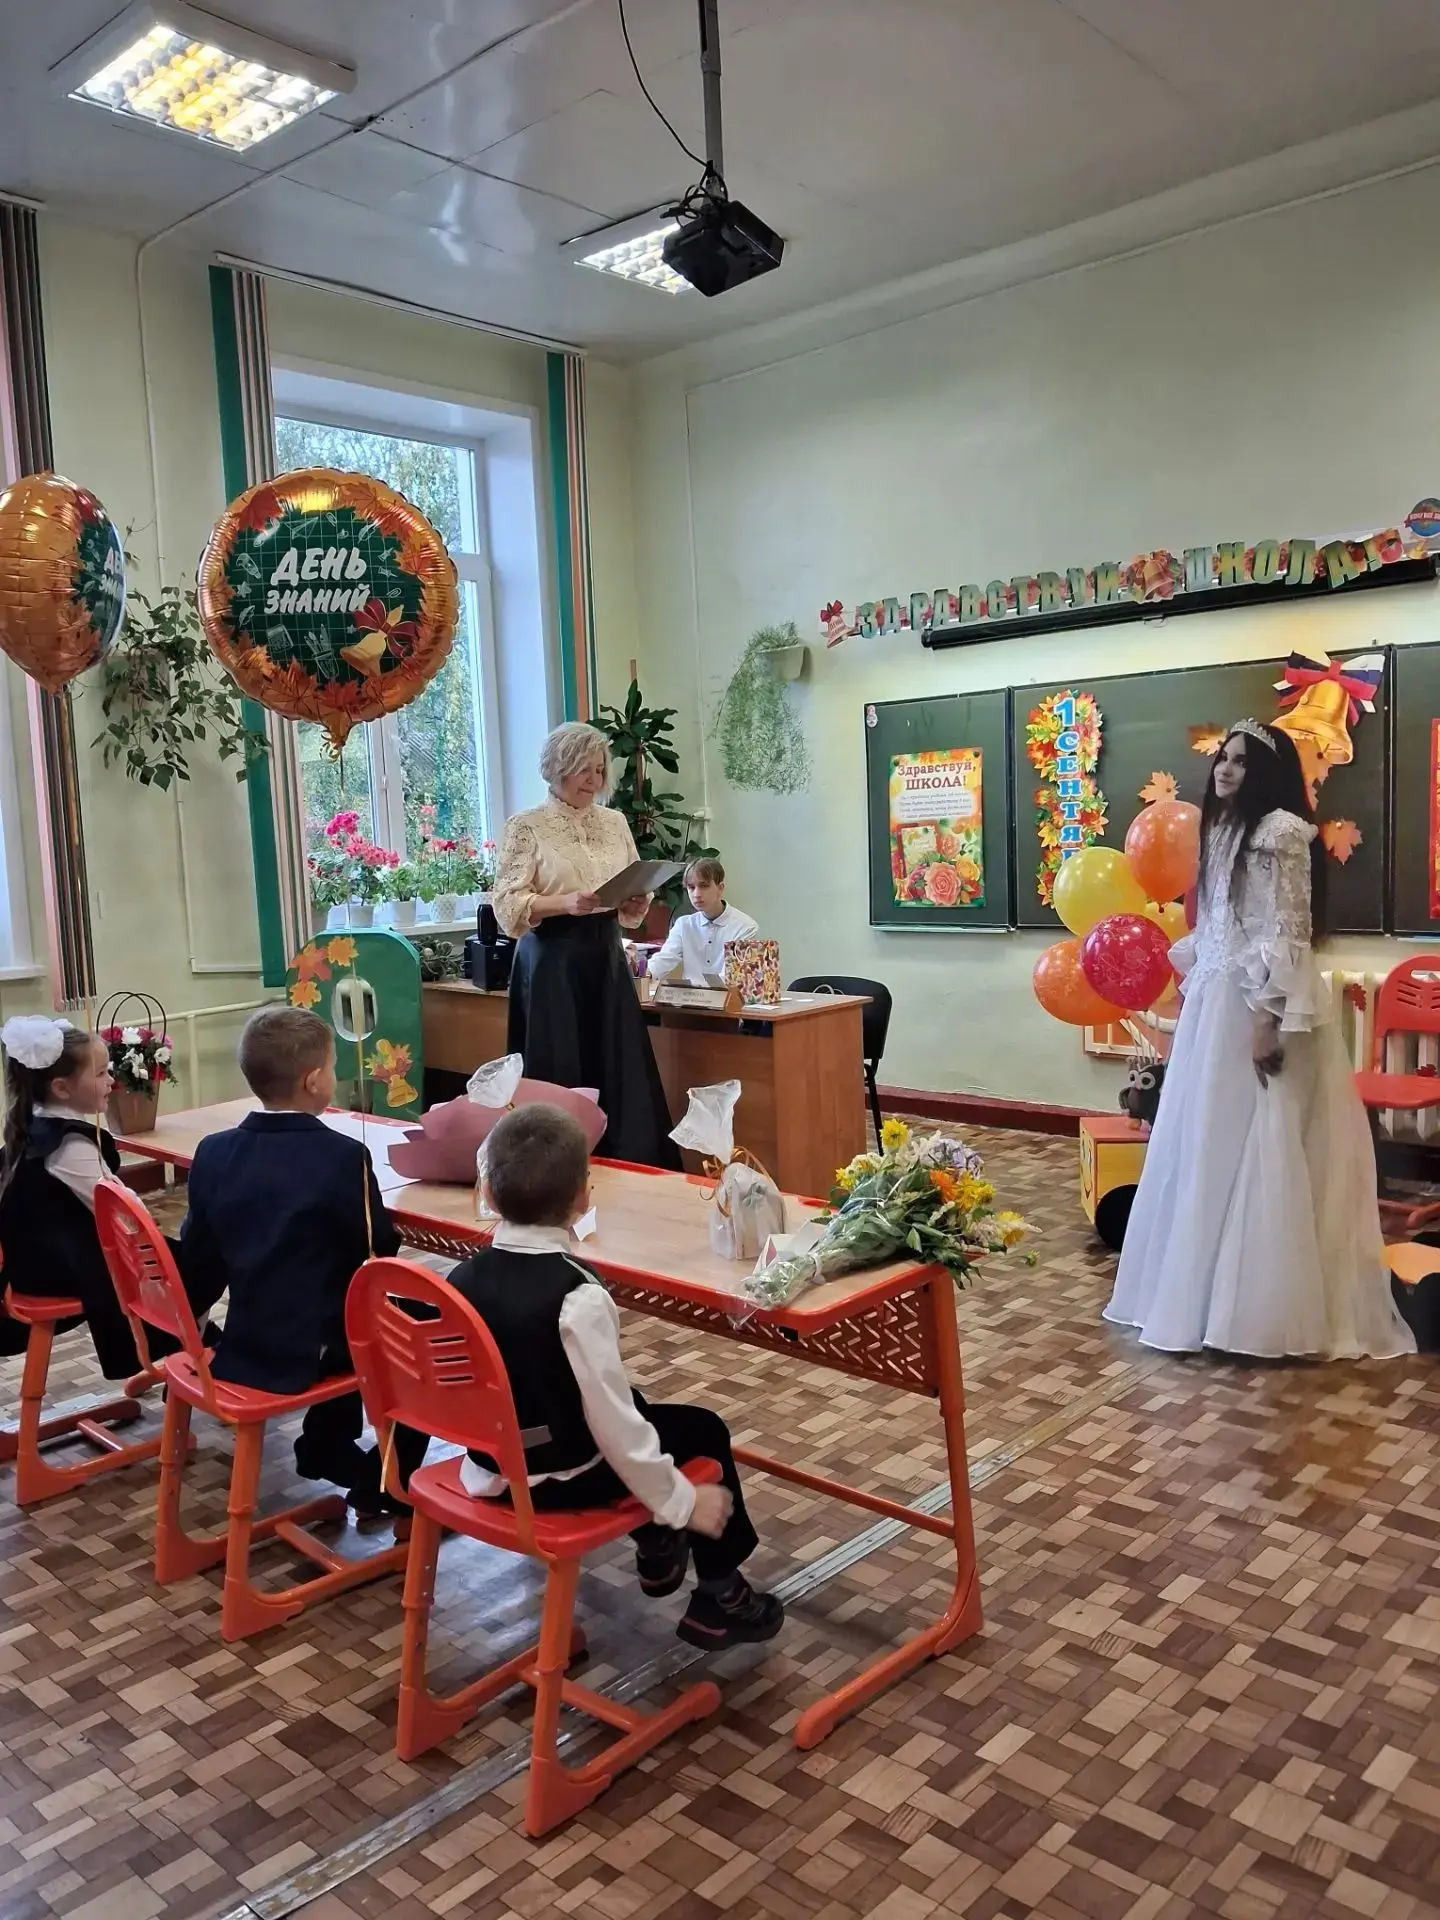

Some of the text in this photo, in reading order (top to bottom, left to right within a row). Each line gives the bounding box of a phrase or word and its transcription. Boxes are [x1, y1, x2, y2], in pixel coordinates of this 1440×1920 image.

[270, 546, 367, 587] ДЕНЬ
[264, 583, 371, 614] ЗНАНИЙ
[1054, 697, 1076, 727] 1
[897, 758, 976, 777] Здравствуй,
[906, 775, 966, 790] ШКОЛА!
[1056, 731, 1083, 862] СЕНТЯ
